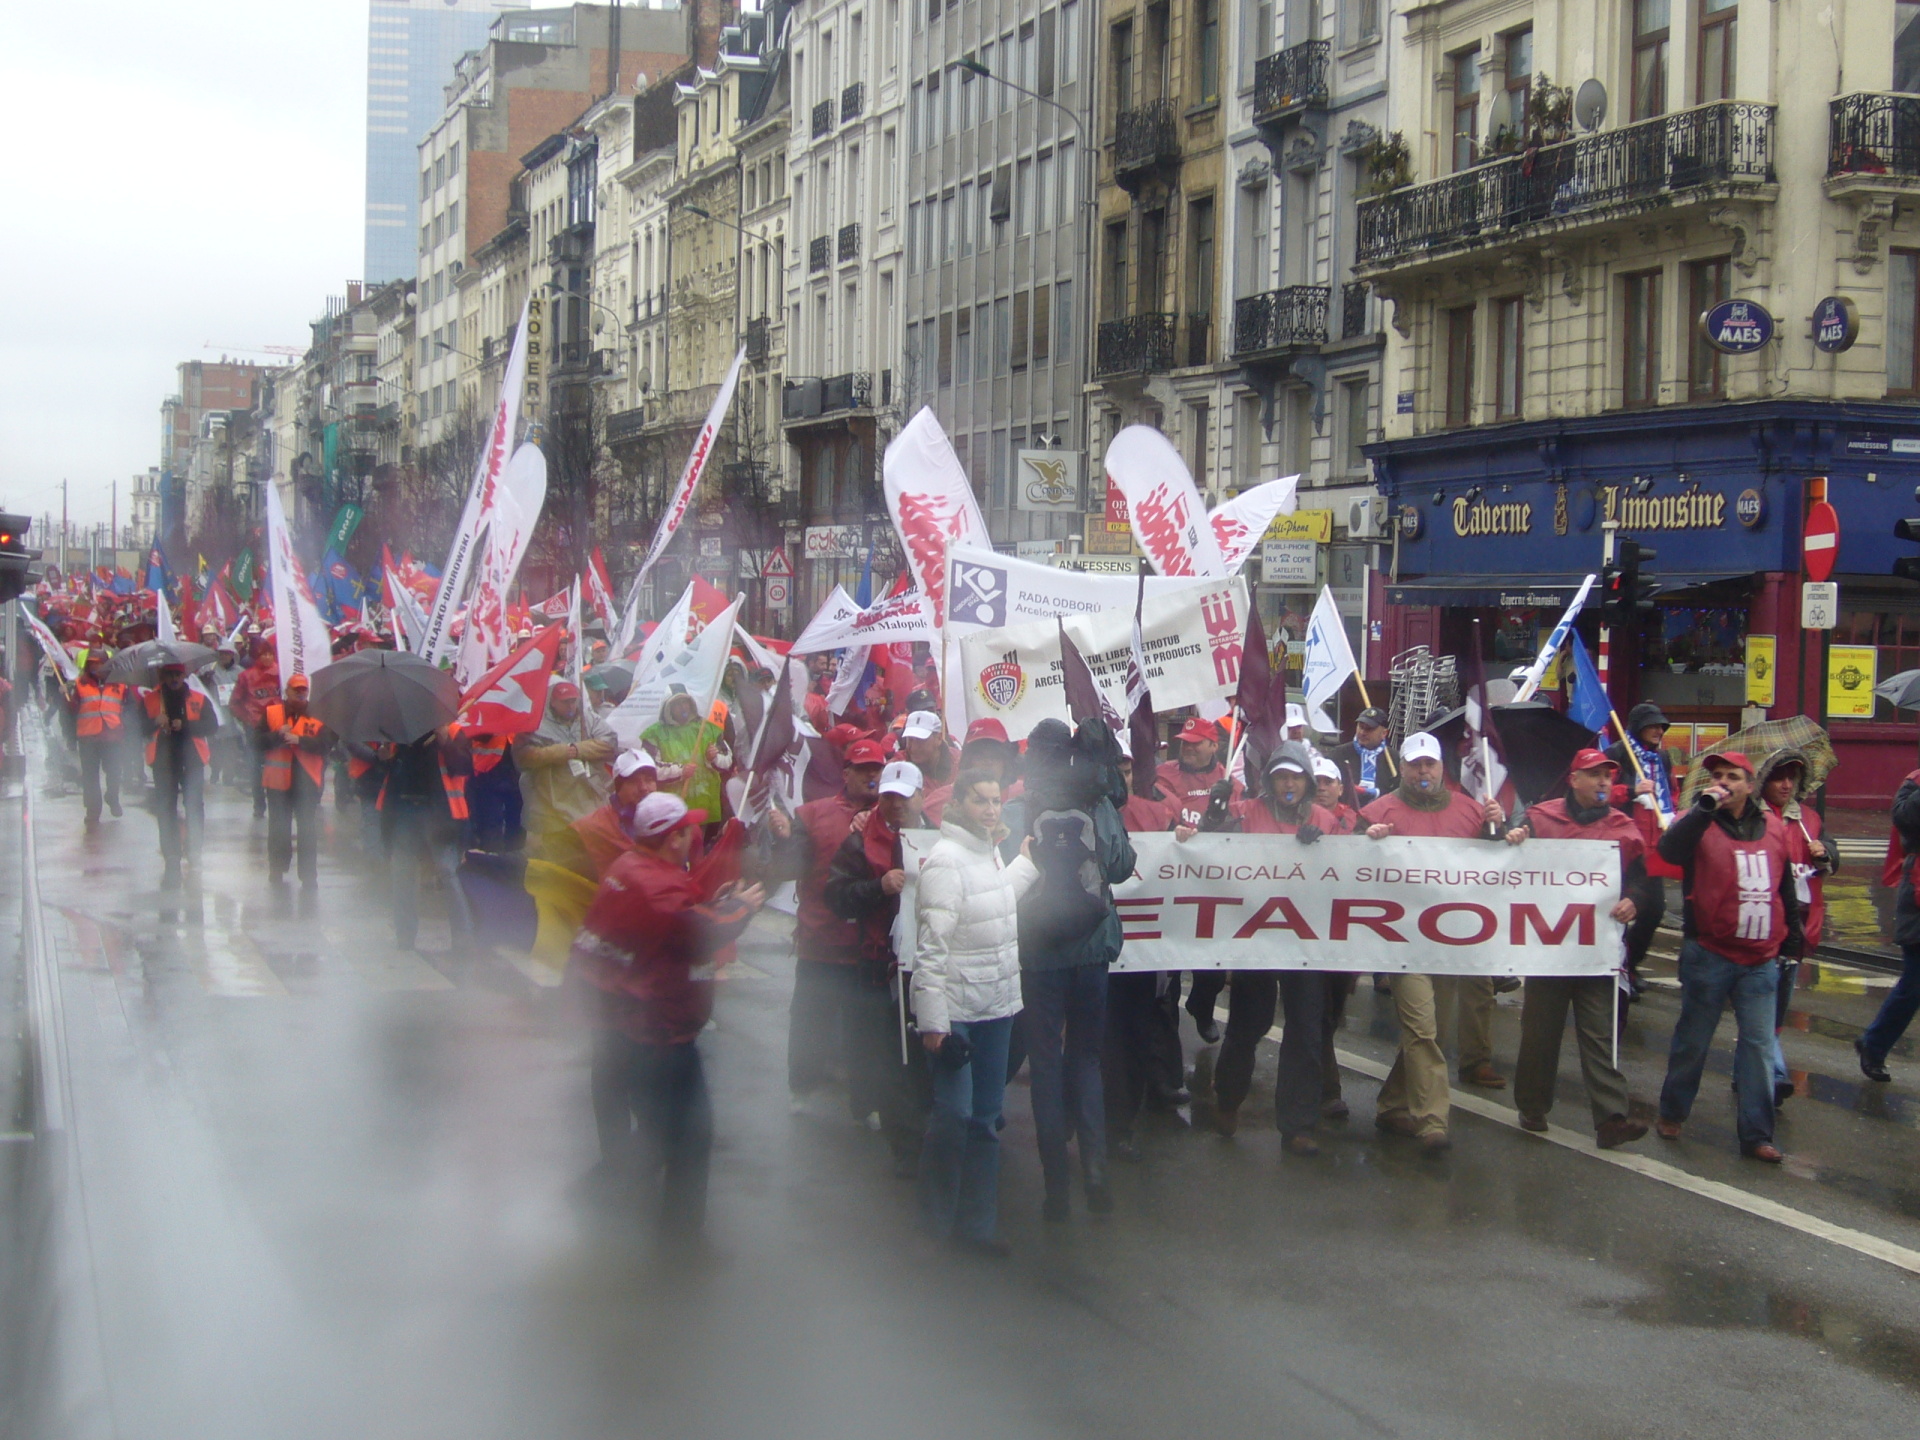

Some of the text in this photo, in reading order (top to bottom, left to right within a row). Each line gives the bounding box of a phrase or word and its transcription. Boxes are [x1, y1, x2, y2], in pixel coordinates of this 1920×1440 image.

[1718, 327, 1762, 343] MAES
[1818, 324, 1842, 342] MAES
[527, 301, 541, 416] ROBERT
[1847, 441, 1888, 450] ANNEESSENS
[1603, 484, 1725, 530] Limousine
[1737, 500, 1759, 514] MAES
[1402, 515, 1418, 528] MAES
[1453, 497, 1532, 537] Taverne
[1267, 543, 1311, 551] PUBLI-PHONE
[1018, 591, 1050, 606] RADA
[1141, 634, 1180, 652] ETROTUB
[1153, 643, 1202, 664] PRODUCTS
[989, 678, 1014, 693] PETRO
[994, 690, 1012, 704] TUB
[1158, 862, 1306, 881] SINDICALĂ
[1319, 866, 1340, 882] A
[1113, 896, 1596, 946] ETAROM
